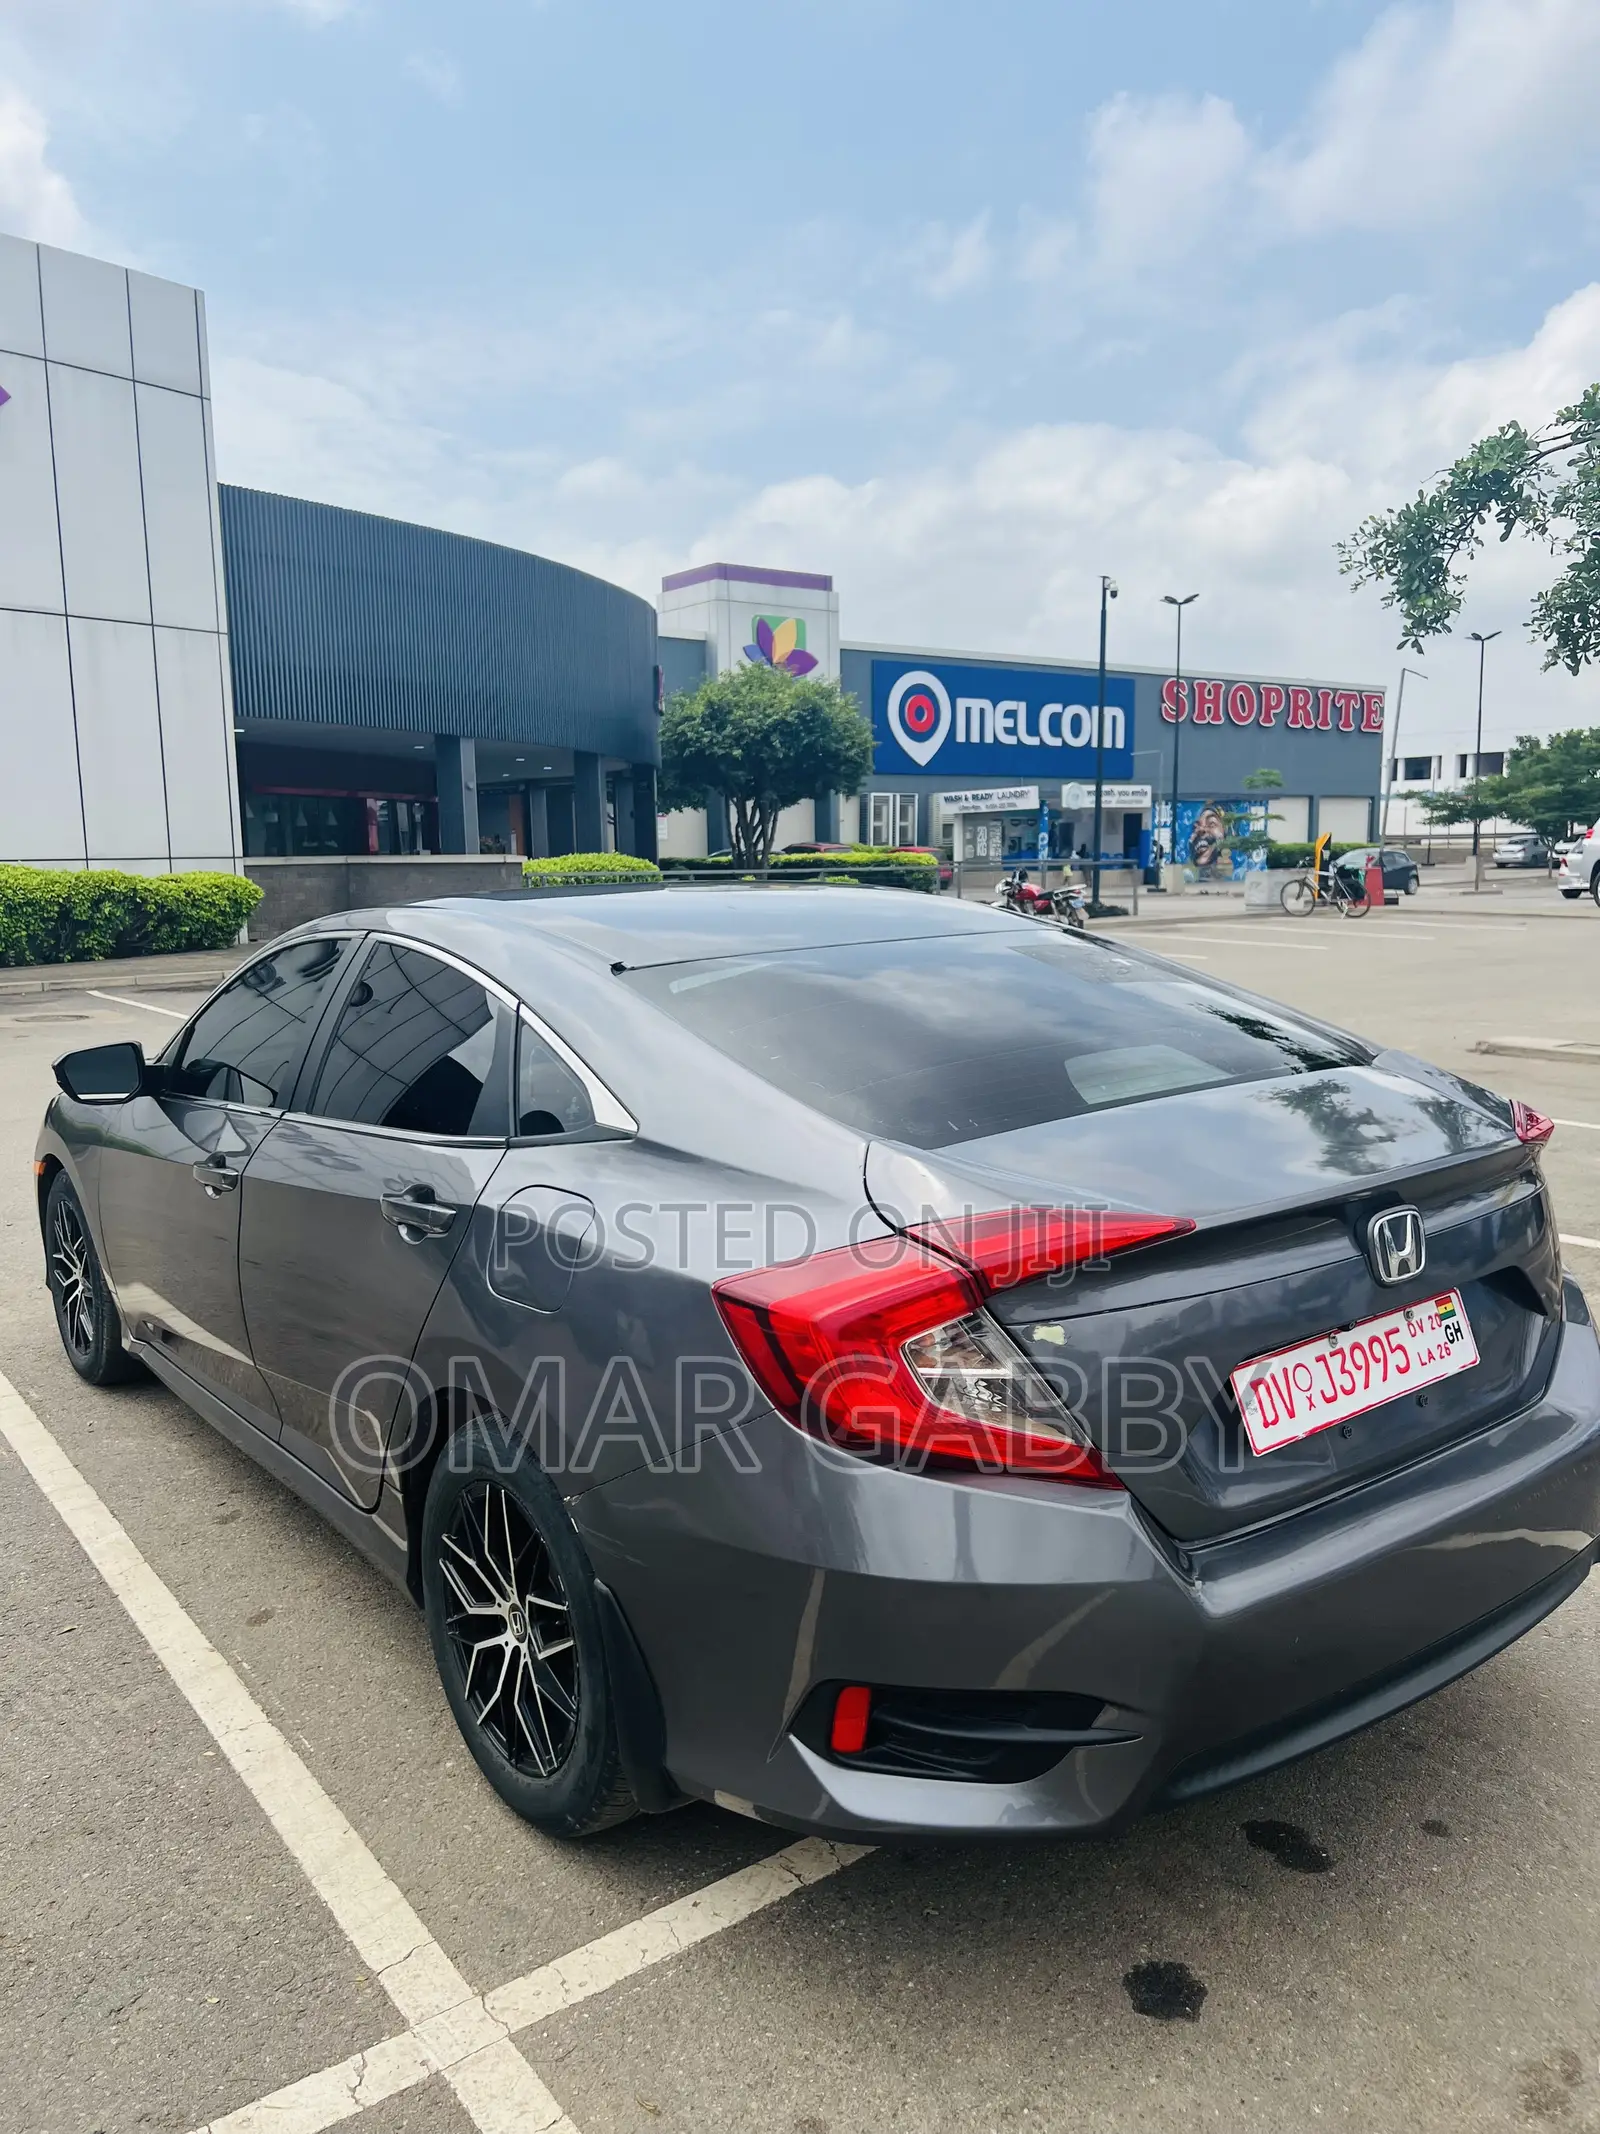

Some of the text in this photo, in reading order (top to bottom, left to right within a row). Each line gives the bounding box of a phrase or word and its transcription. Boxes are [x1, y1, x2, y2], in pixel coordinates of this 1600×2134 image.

[1162, 677, 1384, 733] SHOPRITE
[955, 697, 1125, 749] MELCOM
[944, 795, 963, 803] WASH
[972, 793, 993, 801] READY
[997, 789, 1029, 799] LAUNDRY
[977, 826, 988, 840] 20
[1407, 1312, 1443, 1338] DV 20
[1444, 1321, 1464, 1345] GH
[1315, 1326, 1411, 1404] J3995
[1417, 1342, 1452, 1367] LA 26
